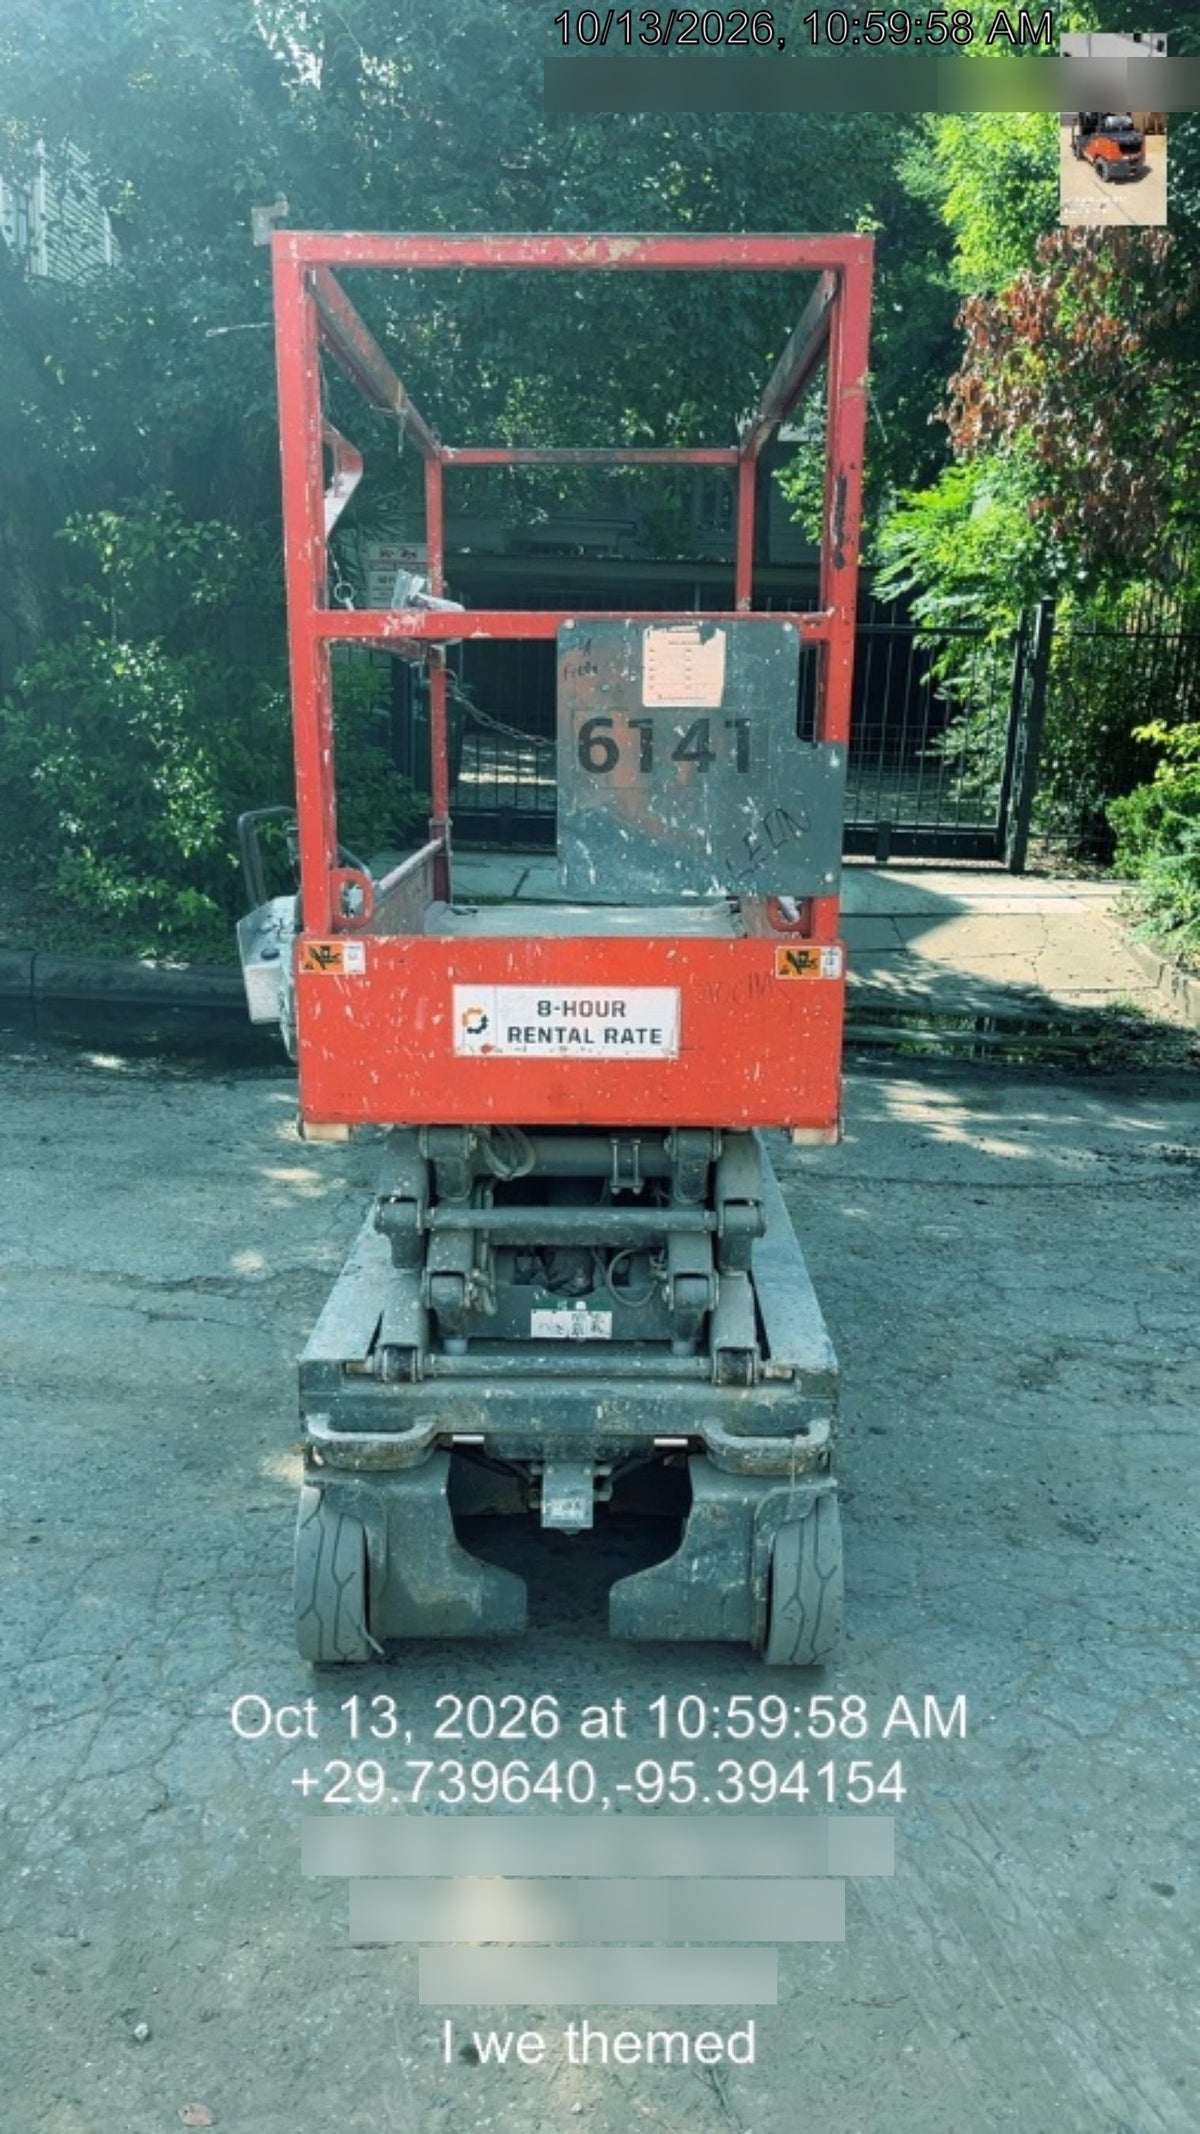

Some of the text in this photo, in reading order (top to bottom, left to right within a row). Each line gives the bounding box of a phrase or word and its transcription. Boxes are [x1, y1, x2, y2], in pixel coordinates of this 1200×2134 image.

[577, 717, 749, 773] 6141
[537, 1000, 626, 1018] 8-HOUR
[506, 1026, 662, 1044] RENTAL RATE
